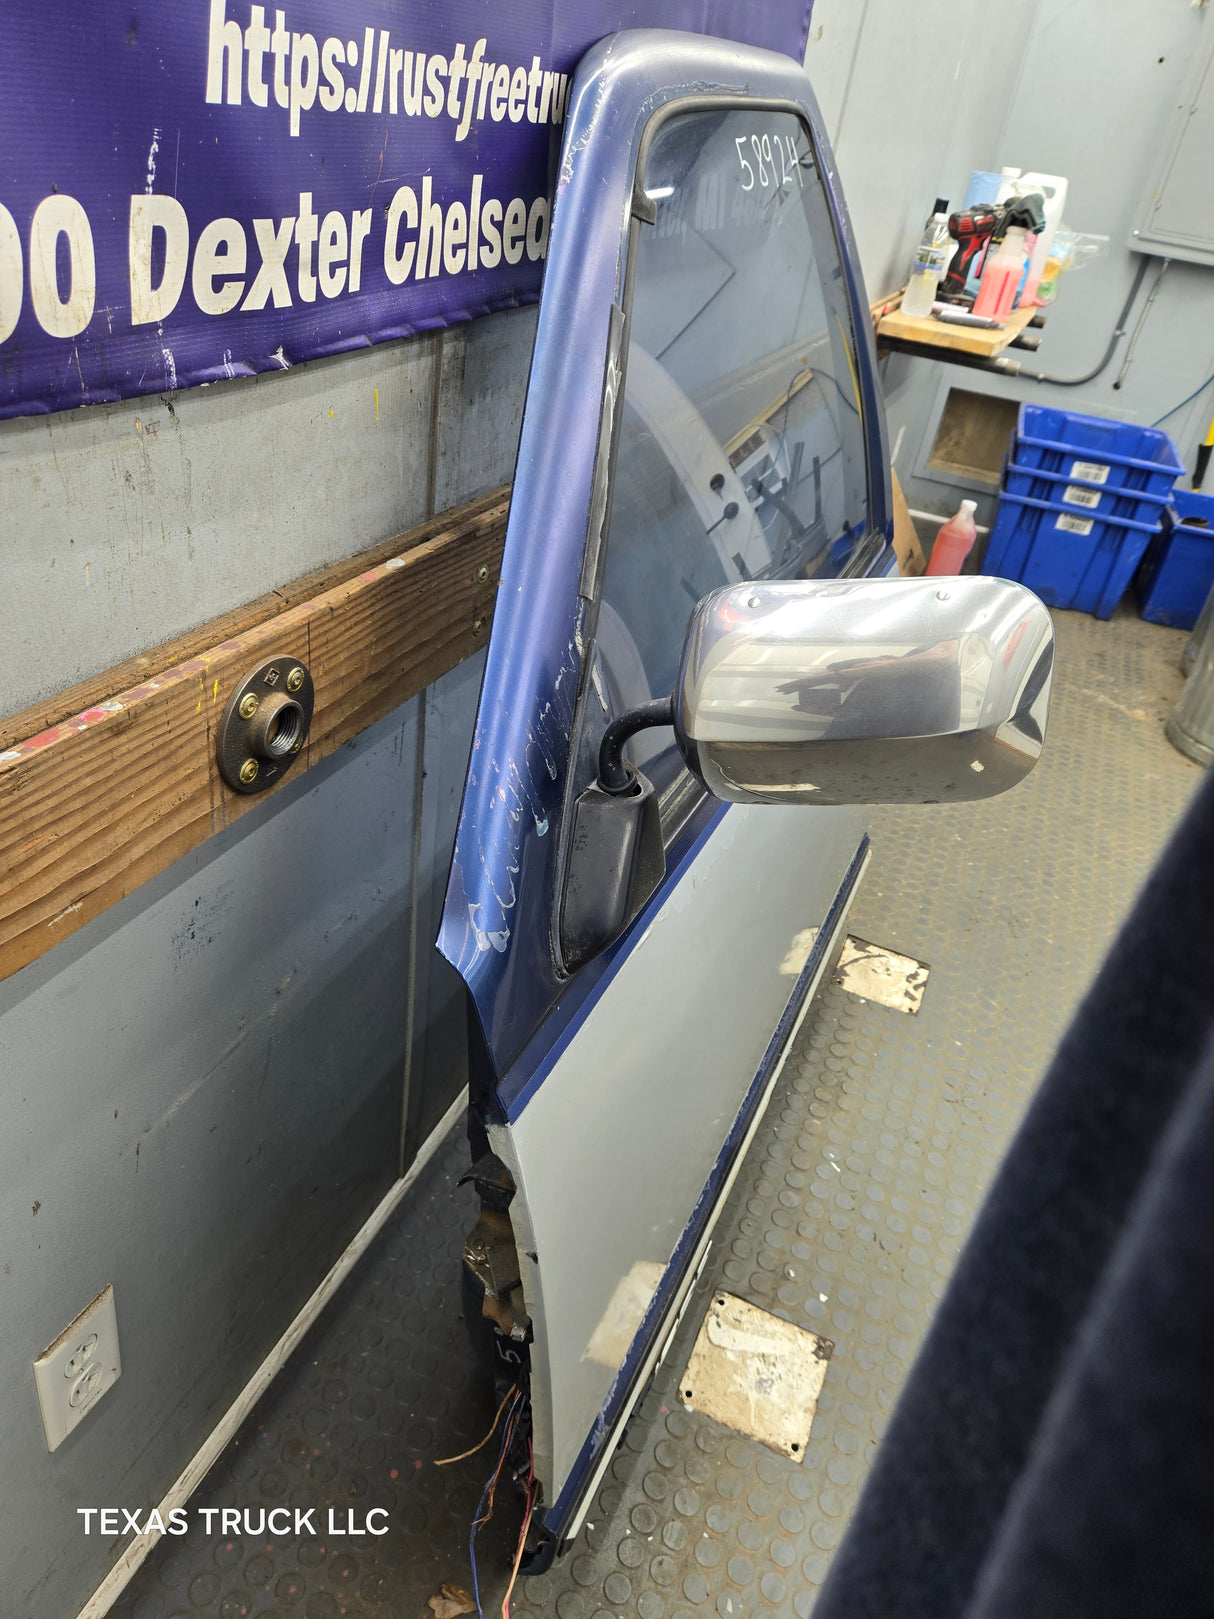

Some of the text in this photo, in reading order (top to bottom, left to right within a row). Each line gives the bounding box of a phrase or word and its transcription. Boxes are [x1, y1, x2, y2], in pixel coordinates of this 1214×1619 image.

[735, 133, 804, 191] 58924
[129, 191, 373, 325] Dexter
[383, 174, 551, 285] Chelsea
